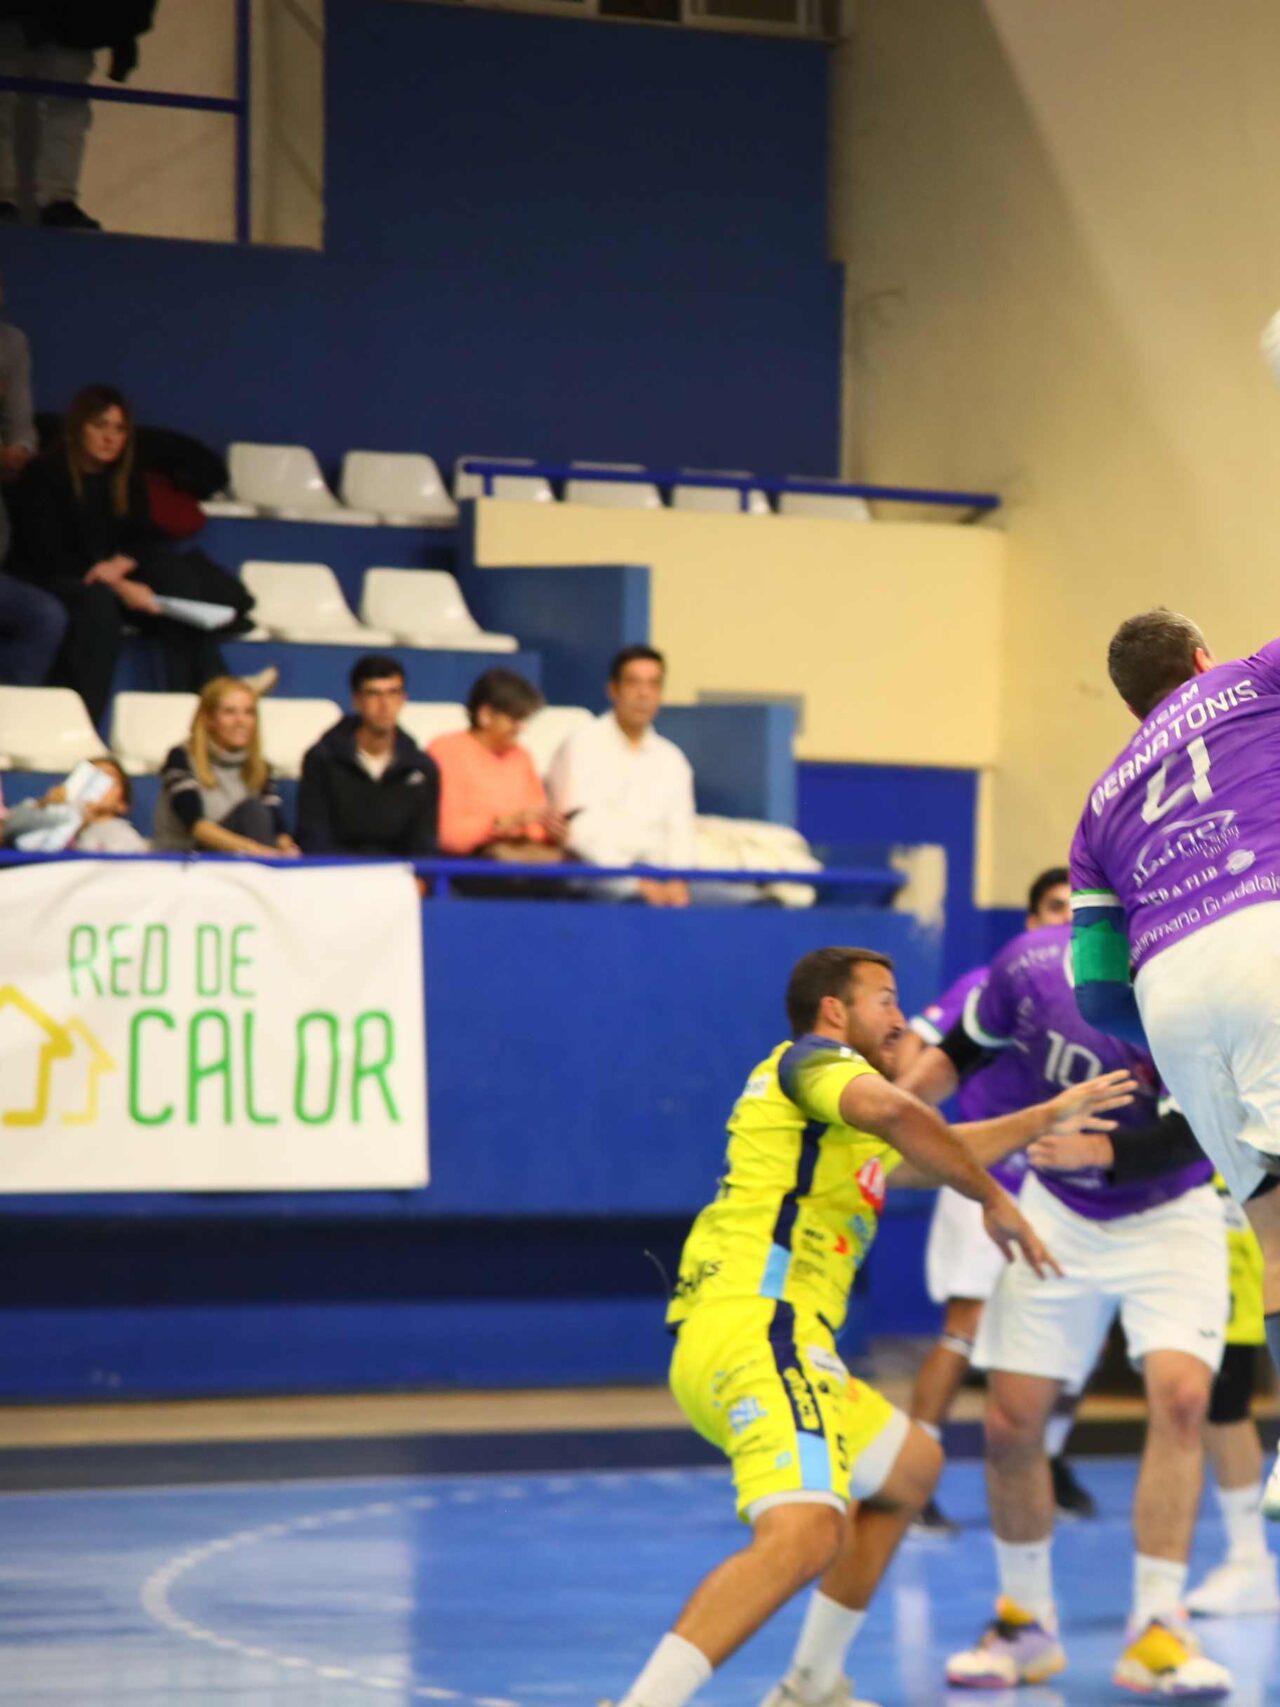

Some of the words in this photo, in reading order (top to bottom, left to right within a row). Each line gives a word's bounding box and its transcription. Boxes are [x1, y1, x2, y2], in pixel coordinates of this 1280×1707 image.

[68, 923, 169, 998] RED
[196, 923, 257, 998] DE
[129, 1008, 402, 1127] CALOR
[1044, 1028, 1104, 1090] 10
